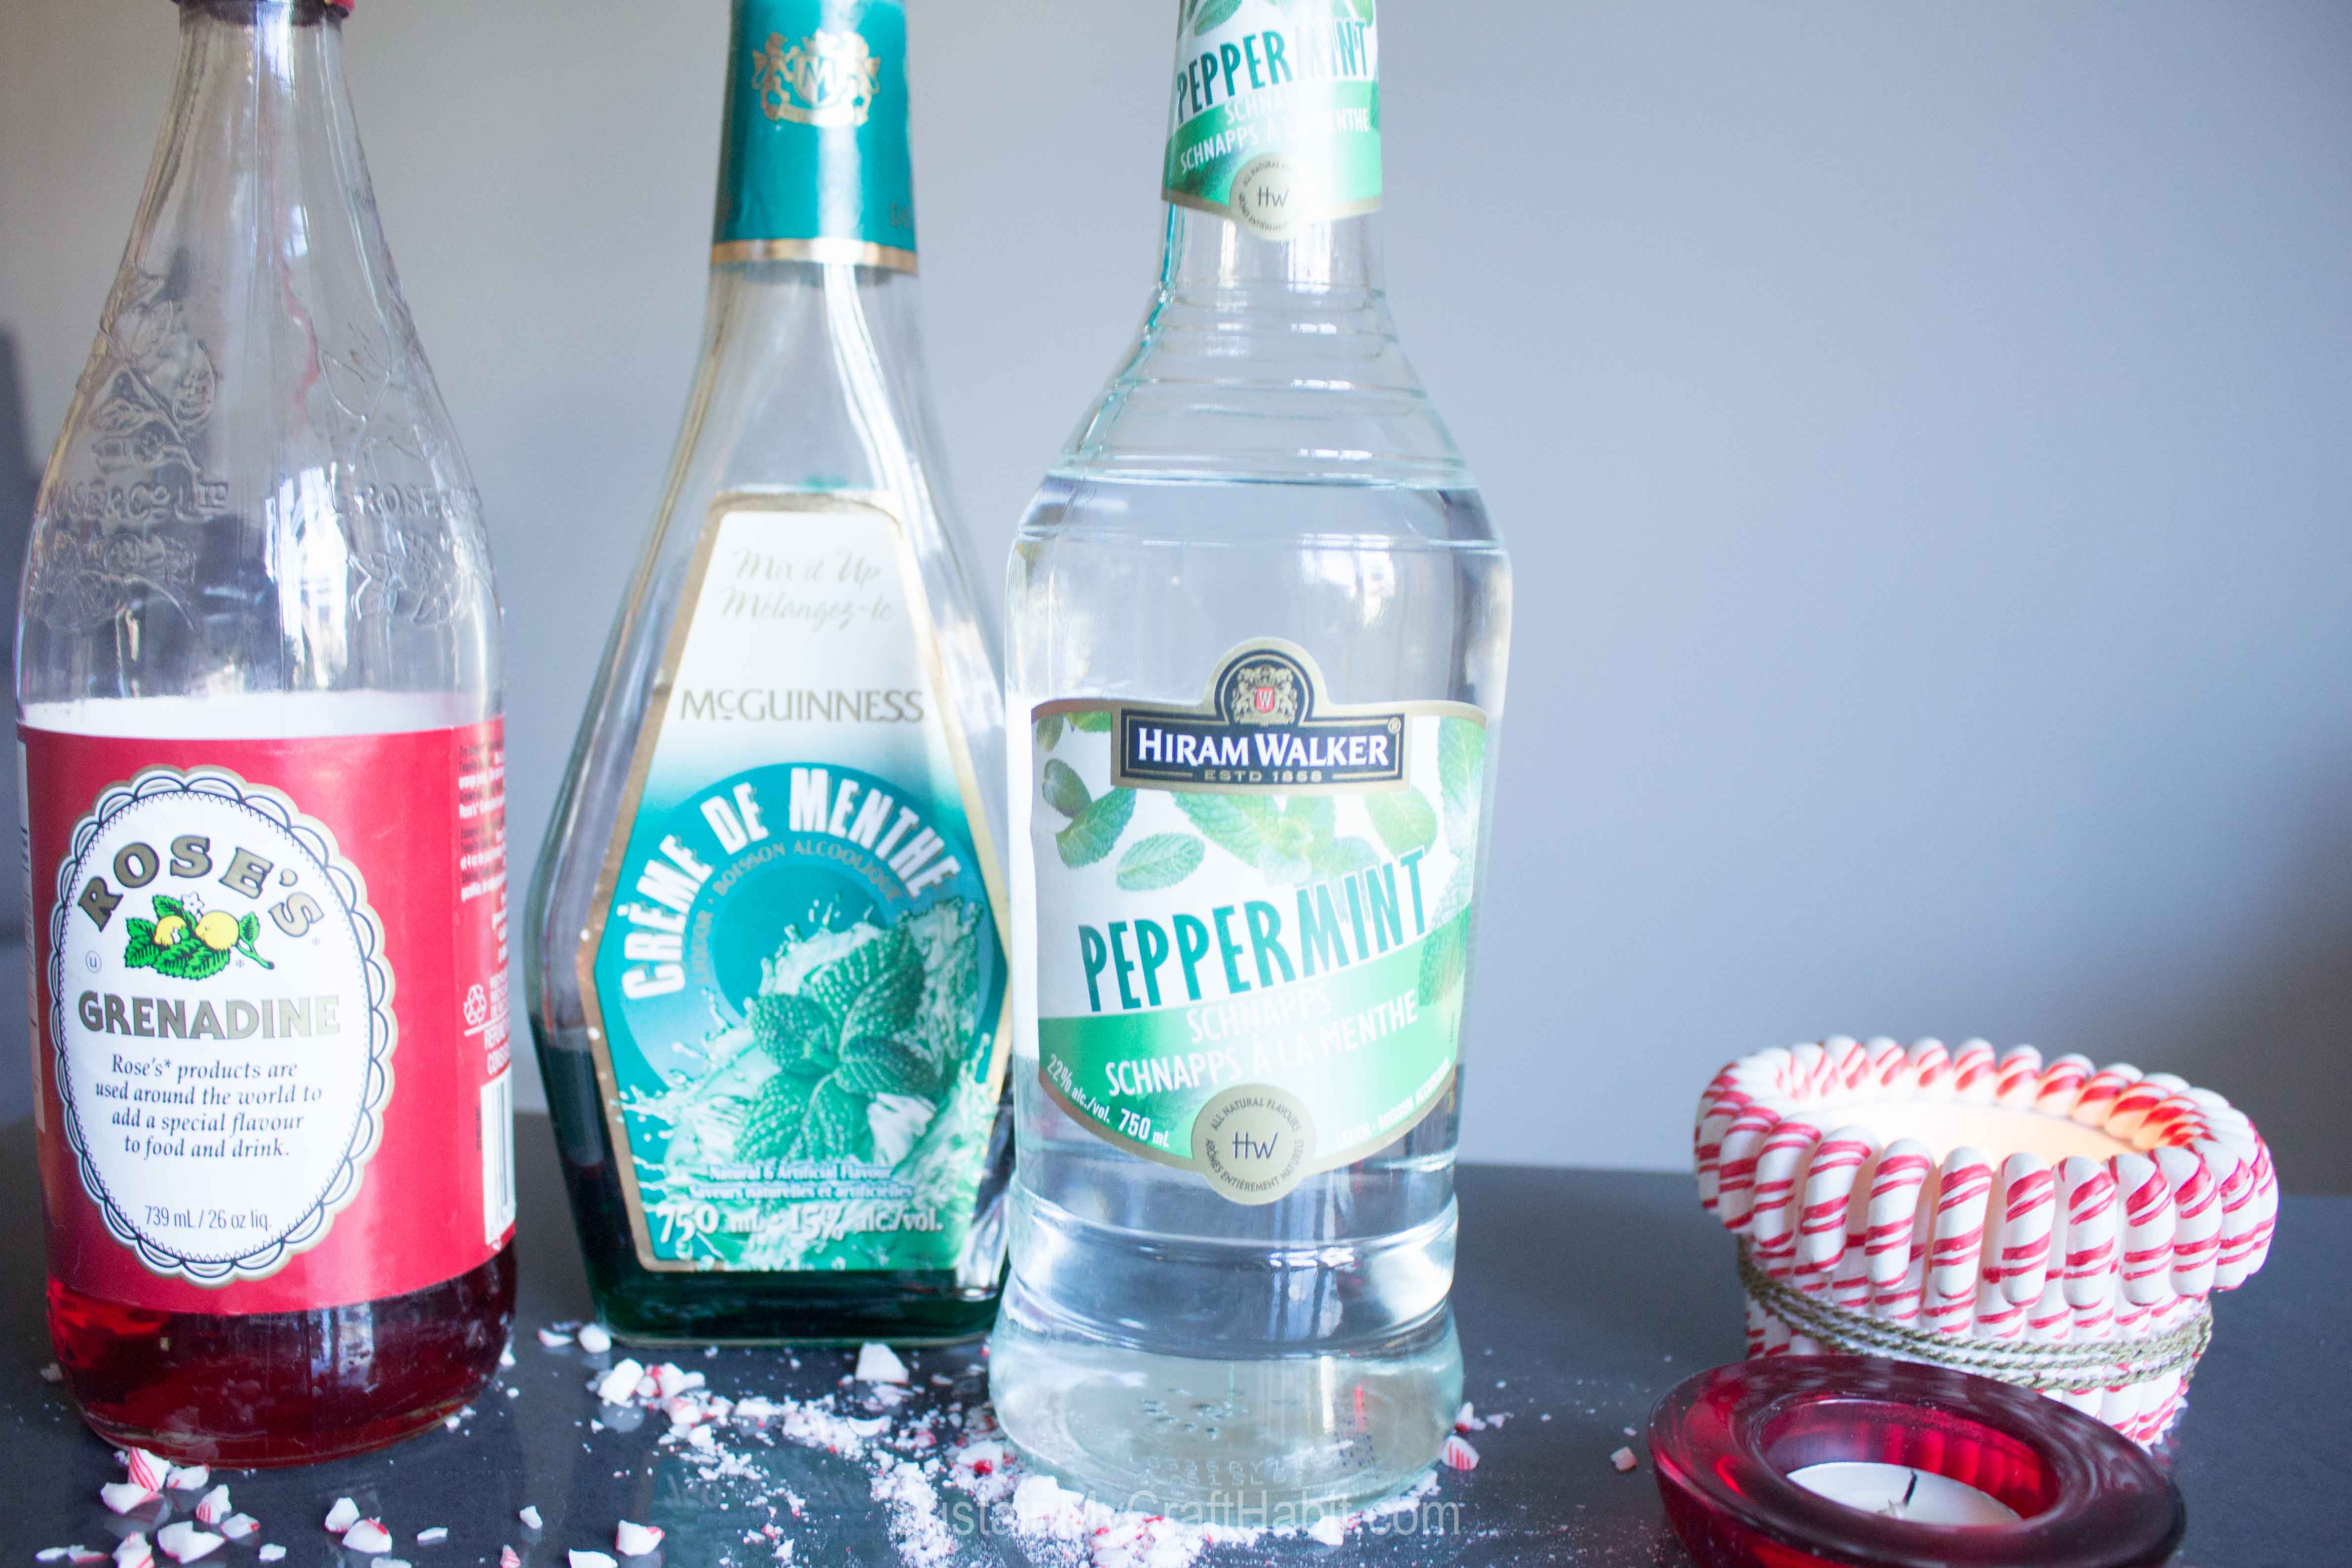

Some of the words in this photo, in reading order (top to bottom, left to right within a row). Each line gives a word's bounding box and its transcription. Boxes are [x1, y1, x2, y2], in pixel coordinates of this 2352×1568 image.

[1225, 87, 1295, 124] SCHNA
[1181, 124, 1259, 175] SCHNAPPS
[1317, 108, 1370, 133] ENTHE
[733, 546, 792, 581] Mix
[836, 548, 881, 591] Up
[718, 586, 893, 632] Mélangez-le
[1137, 728, 1249, 767] HIRAM
[1254, 733, 1389, 767] WALKER
[1204, 770, 1263, 783] ESTD
[700, 783, 770, 855] DE
[789, 768, 961, 899] MENTHE
[77, 834, 325, 937] ROSE'S
[712, 841, 786, 896] BOISSON
[793, 839, 902, 903] ALCOOLIQUE
[1078, 851, 1425, 1012] PEPPERMINT
[78, 990, 340, 1040] GRENADINE
[1187, 983, 1331, 1044] SCHNAPPS
[1105, 1046, 1242, 1097] SCHNAPPS
[1277, 1033, 1315, 1070] LA
[1322, 989, 1418, 1055] MENTHE
[178, 1060, 261, 1084] products
[268, 1064, 297, 1079] are
[1047, 1053, 1072, 1094] 22%
[96, 1082, 128, 1101] used
[133, 1085, 195, 1105] around
[202, 1085, 231, 1105] the
[238, 1084, 296, 1105] world
[303, 1085, 322, 1102] to
[112, 1107, 141, 1129] add
[147, 1115, 156, 1129] a
[161, 1112, 225, 1136] special
[230, 1112, 304, 1138] flavour
[1119, 1108, 1151, 1142] 750
[1153, 1130, 1169, 1149] mL
[1210, 1114, 1225, 1131] ALL
[1222, 1097, 1264, 1117] NATURAL
[1267, 1098, 1302, 1132] FLAVOURS
[124, 1135, 140, 1153] to
[144, 1137, 185, 1160] food
[191, 1137, 225, 1158] and
[232, 1137, 290, 1158] drink.
[1279, 1139, 1304, 1182] NATURELS
[145, 1205, 169, 1227] 739
[174, 1208, 194, 1229] mL
[208, 1209, 226, 1229] 26
[231, 1214, 246, 1229] oz
[251, 1209, 272, 1232] liq.
[658, 1203, 720, 1243] 750
[789, 1204, 845, 1242] 15%
